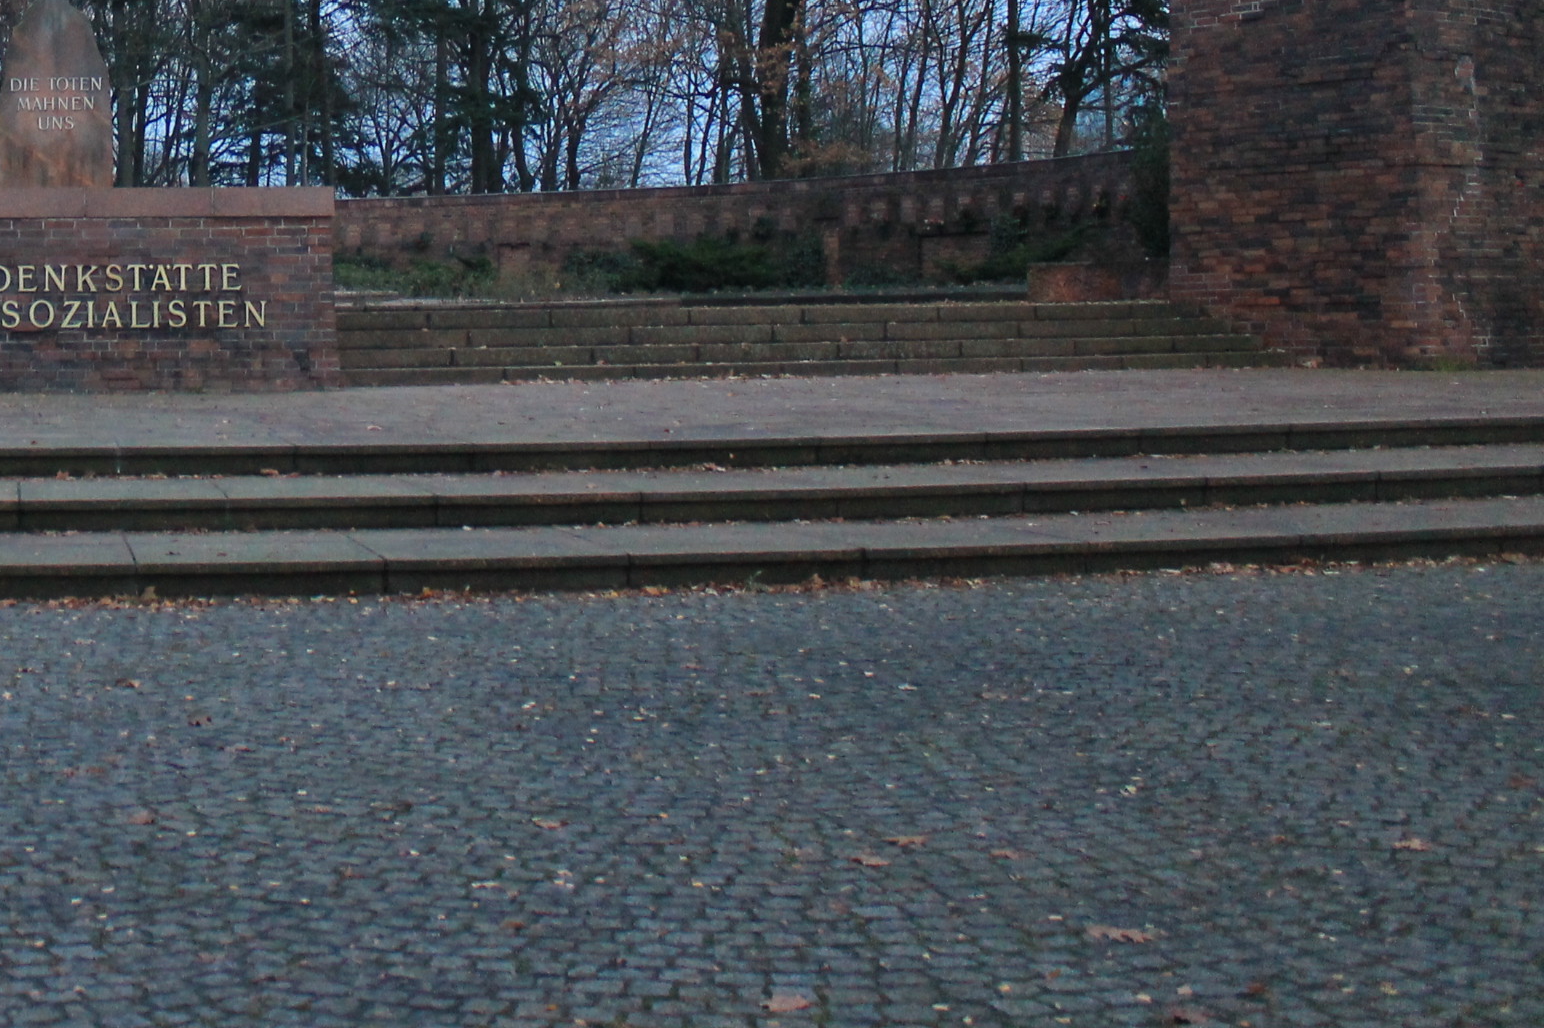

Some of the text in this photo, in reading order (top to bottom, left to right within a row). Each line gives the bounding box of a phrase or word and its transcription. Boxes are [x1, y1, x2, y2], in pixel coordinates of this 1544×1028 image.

[10, 77, 102, 91] DIE TOTEN
[17, 97, 94, 110] MAHNEN
[38, 116, 75, 130] UNS
[1, 299, 268, 329] SOZIALISTEN
